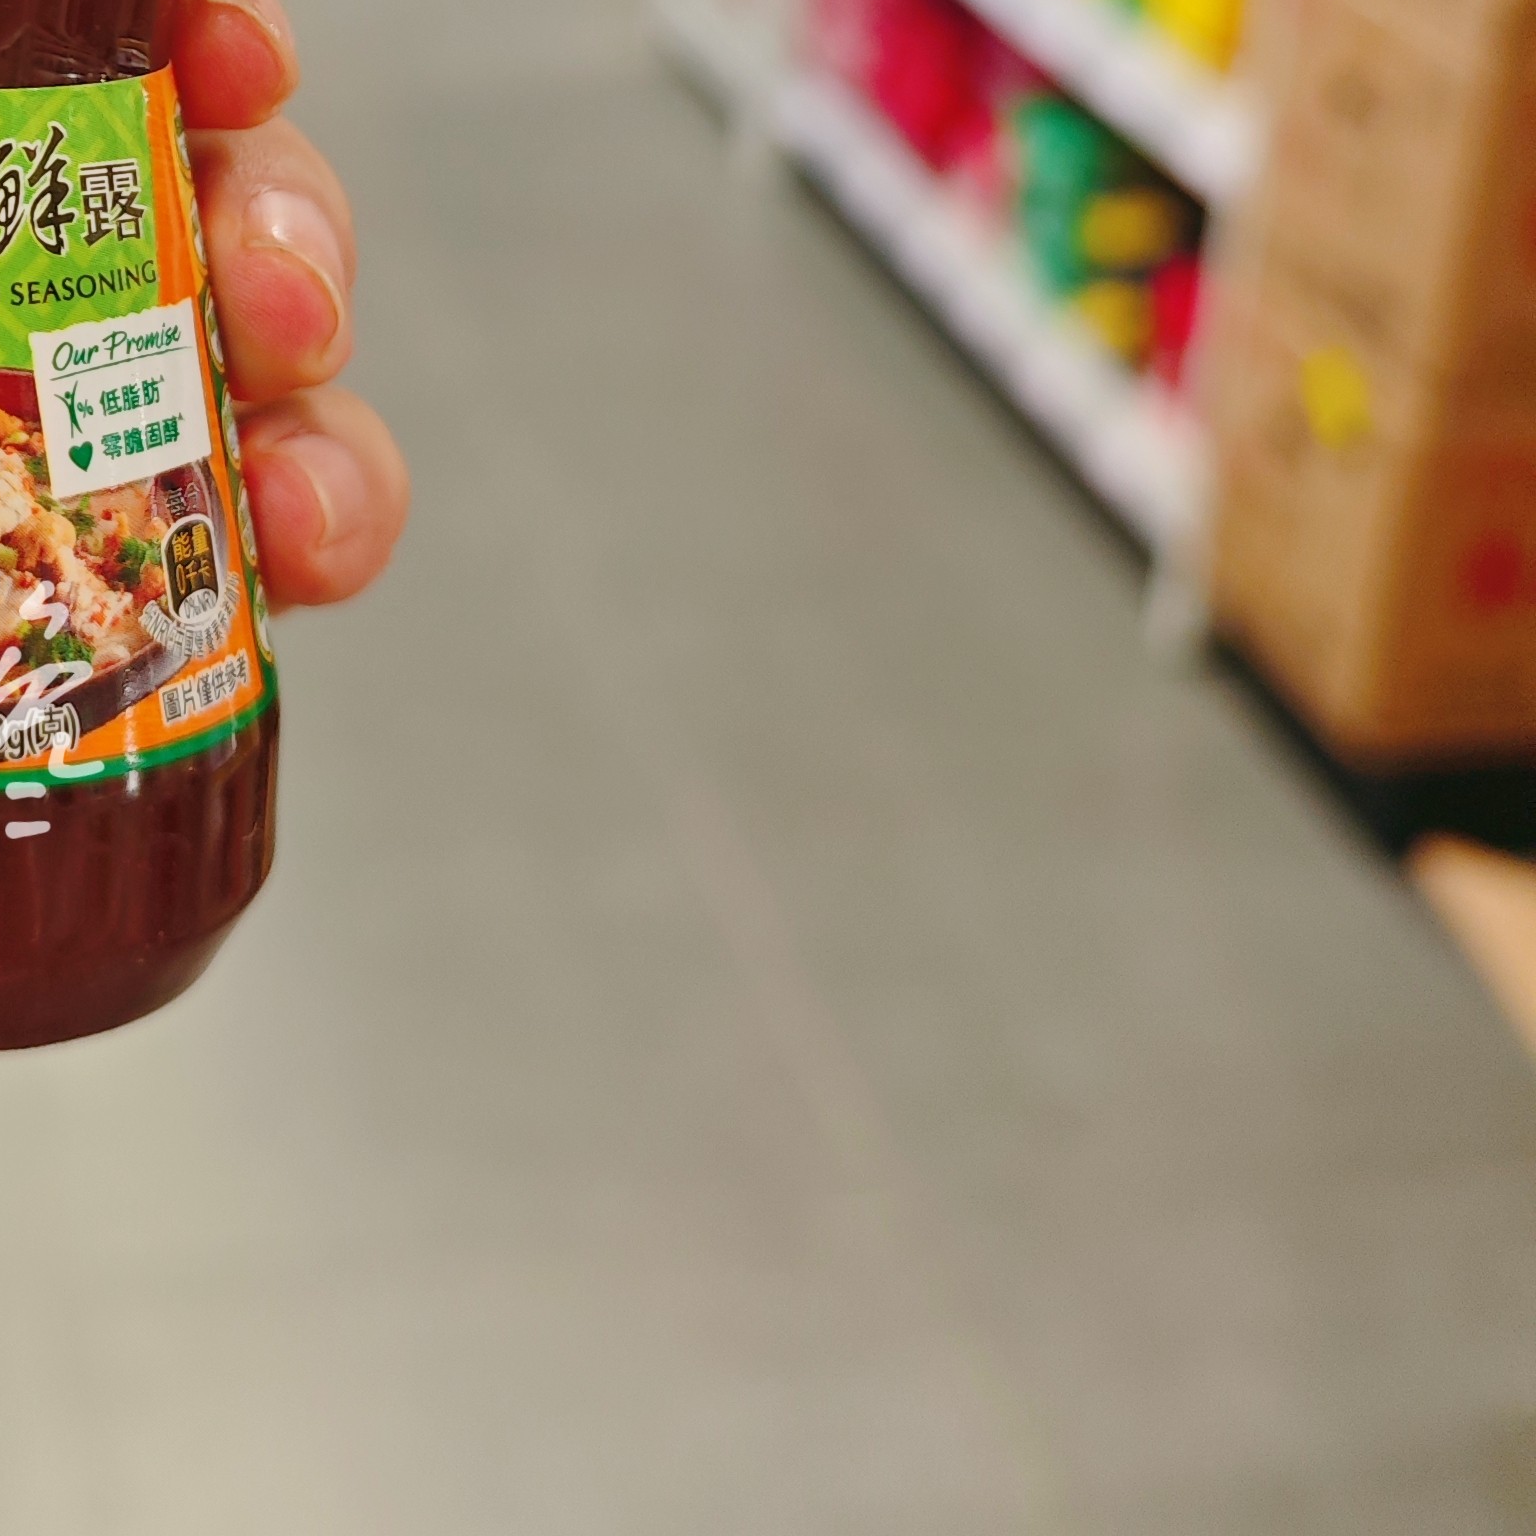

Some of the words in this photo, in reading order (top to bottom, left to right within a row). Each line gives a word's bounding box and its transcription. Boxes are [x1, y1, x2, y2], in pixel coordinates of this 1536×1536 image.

[9, 259, 158, 306] SEASONING
[51, 340, 100, 372] Our
[102, 322, 182, 360] Promise
[171, 522, 210, 563] 能量
[161, 654, 248, 723] 圖片僅供參考
